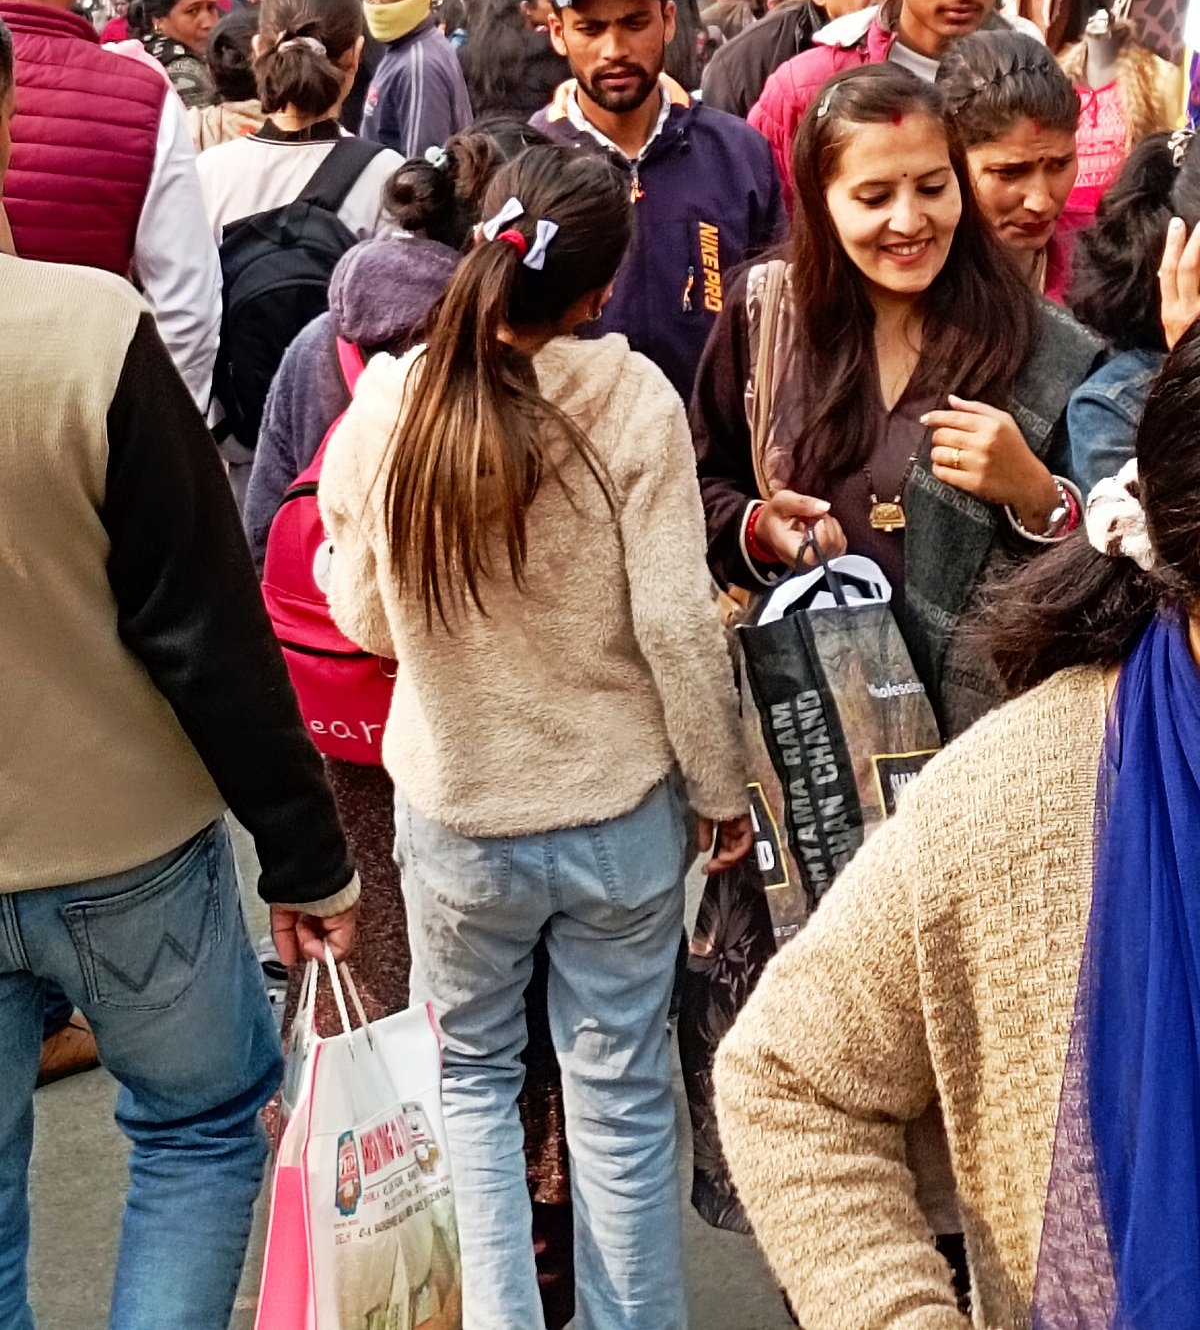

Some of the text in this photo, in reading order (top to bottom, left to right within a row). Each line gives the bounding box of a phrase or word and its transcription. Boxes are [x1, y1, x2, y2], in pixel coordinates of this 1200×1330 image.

[309, 720, 382, 744] ear
[770, 701, 802, 767] RAM
[796, 689, 839, 786] CHAND
